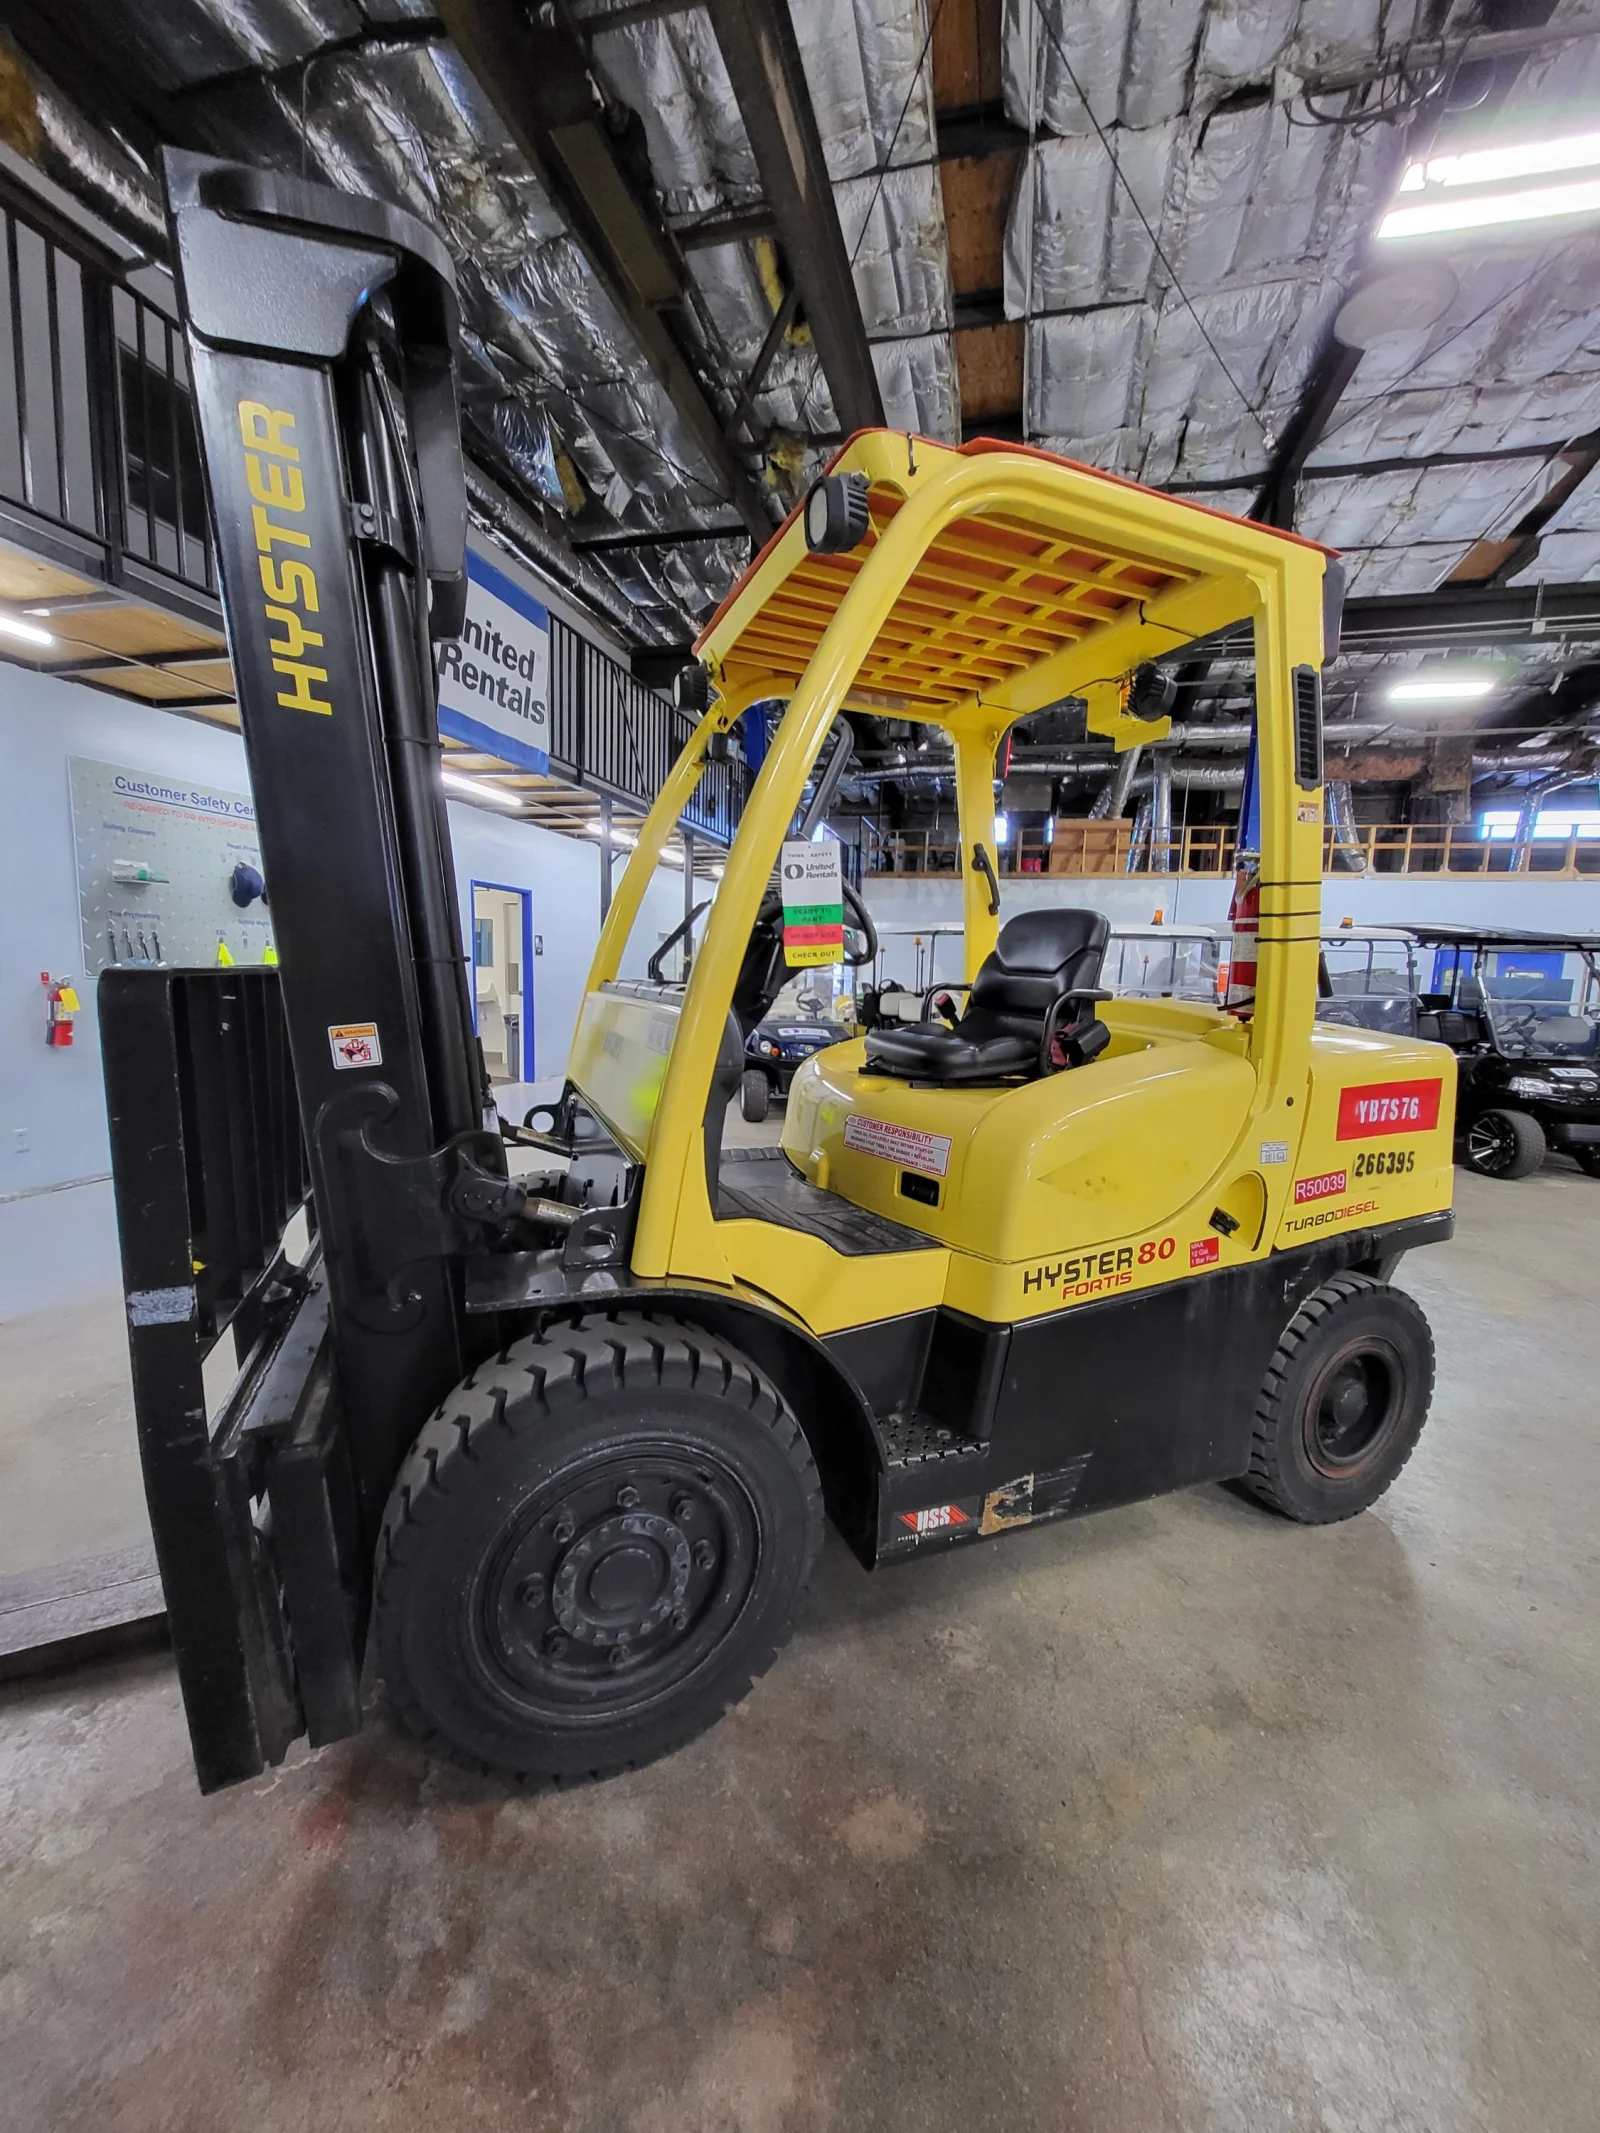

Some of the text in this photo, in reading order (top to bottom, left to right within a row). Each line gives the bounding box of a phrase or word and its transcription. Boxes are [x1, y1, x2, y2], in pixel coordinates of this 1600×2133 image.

[238, 400, 332, 715] HYSTER
[463, 617, 535, 683] nited
[438, 643, 545, 725] Rentals
[115, 776, 187, 802] Customer
[190, 792, 231, 813] Safety
[124, 801, 169, 816] REQUIRED
[171, 809, 182, 818] TO
[198, 814, 216, 825] INTO
[102, 822, 156, 837] Safety Glasses
[806, 862, 835, 871] United
[806, 871, 838, 880] Rentals
[344, 1028, 373, 1036] WARNING
[857, 1118, 934, 1145] CUSTOMER RESPONSIBILITY
[913, 1153, 936, 1164] REFUELING
[914, 1145, 934, 1155] START-UP
[893, 1154, 919, 1167] MAINTENANCE
[921, 1163, 942, 1174] CLEANING
[1355, 1151, 1415, 1177] 266395
[1295, 1173, 1345, 1200] R50039
[1285, 1200, 1380, 1233] TURBODIESEL
[1191, 1241, 1204, 1250] MAX
[1191, 1250, 1198, 1258] 12
[1023, 1237, 1176, 1294] HYSTER 80
[1195, 1257, 1205, 1265] Bar
[1205, 1252, 1218, 1262] Fuel
[1062, 1271, 1133, 1300] FORTIS
[917, 1505, 951, 1532] HSS
